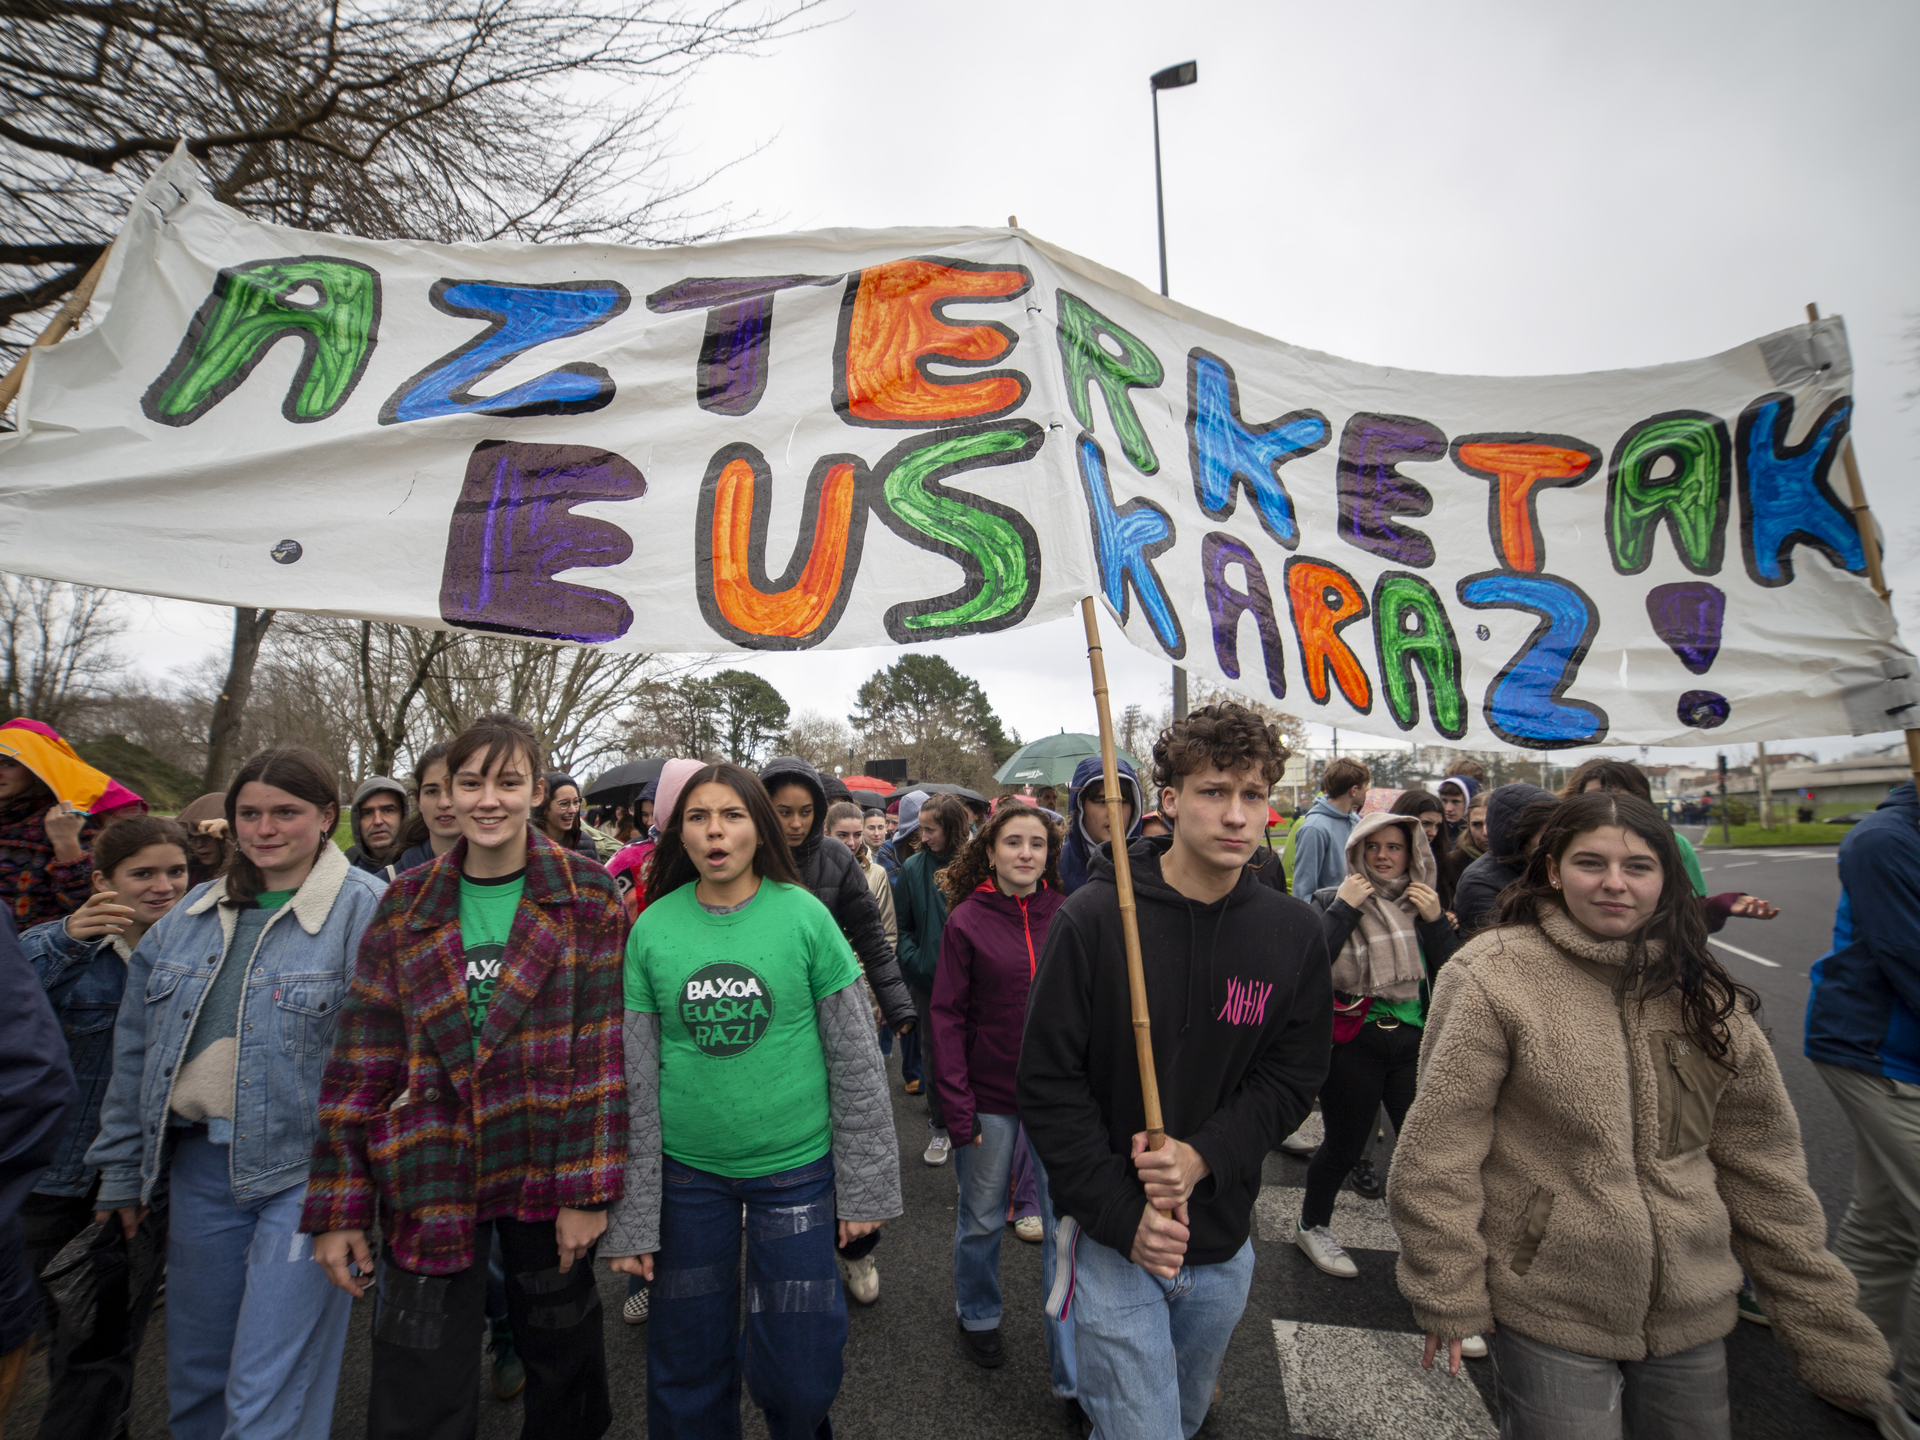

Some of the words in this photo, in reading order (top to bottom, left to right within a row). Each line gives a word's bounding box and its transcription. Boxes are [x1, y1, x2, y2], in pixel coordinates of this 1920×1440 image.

[141, 254, 1882, 587] AZTERKETAK
[438, 418, 1730, 749] EUSKARAZ!
[687, 978, 763, 1001] BAXOA
[695, 1022, 755, 1047] RAZ!
